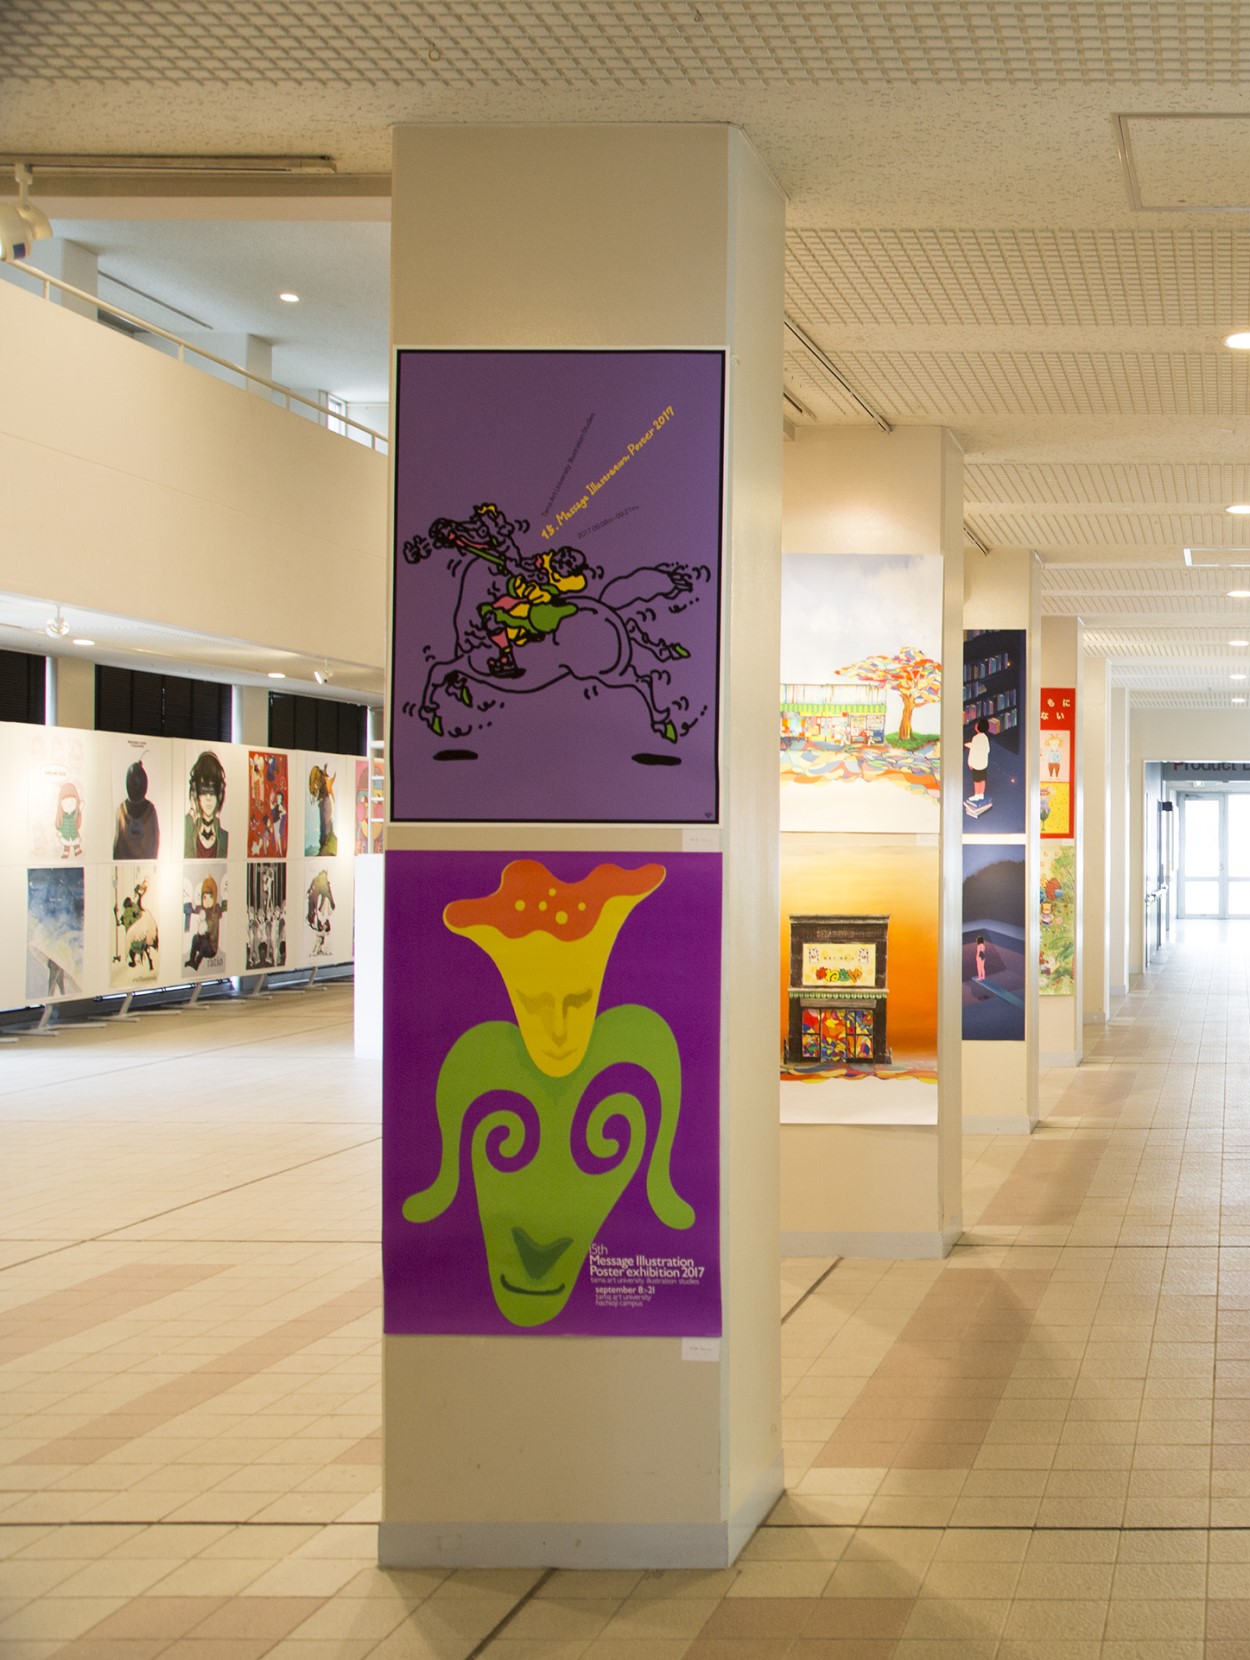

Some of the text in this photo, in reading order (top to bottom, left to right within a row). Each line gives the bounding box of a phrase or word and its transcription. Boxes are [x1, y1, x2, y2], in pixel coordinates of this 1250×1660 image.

[555, 495, 590, 526] Message
[586, 455, 630, 496] Illustration
[627, 428, 656, 456] Poster
[653, 405, 676, 431] 2017
[1173, 762, 1236, 771] Product
[207, 956, 224, 968] ratio
[590, 1255, 694, 1269] Message Illustration
[590, 1266, 705, 1278] Poster exhibition 2017
[595, 1286, 637, 1296] september
